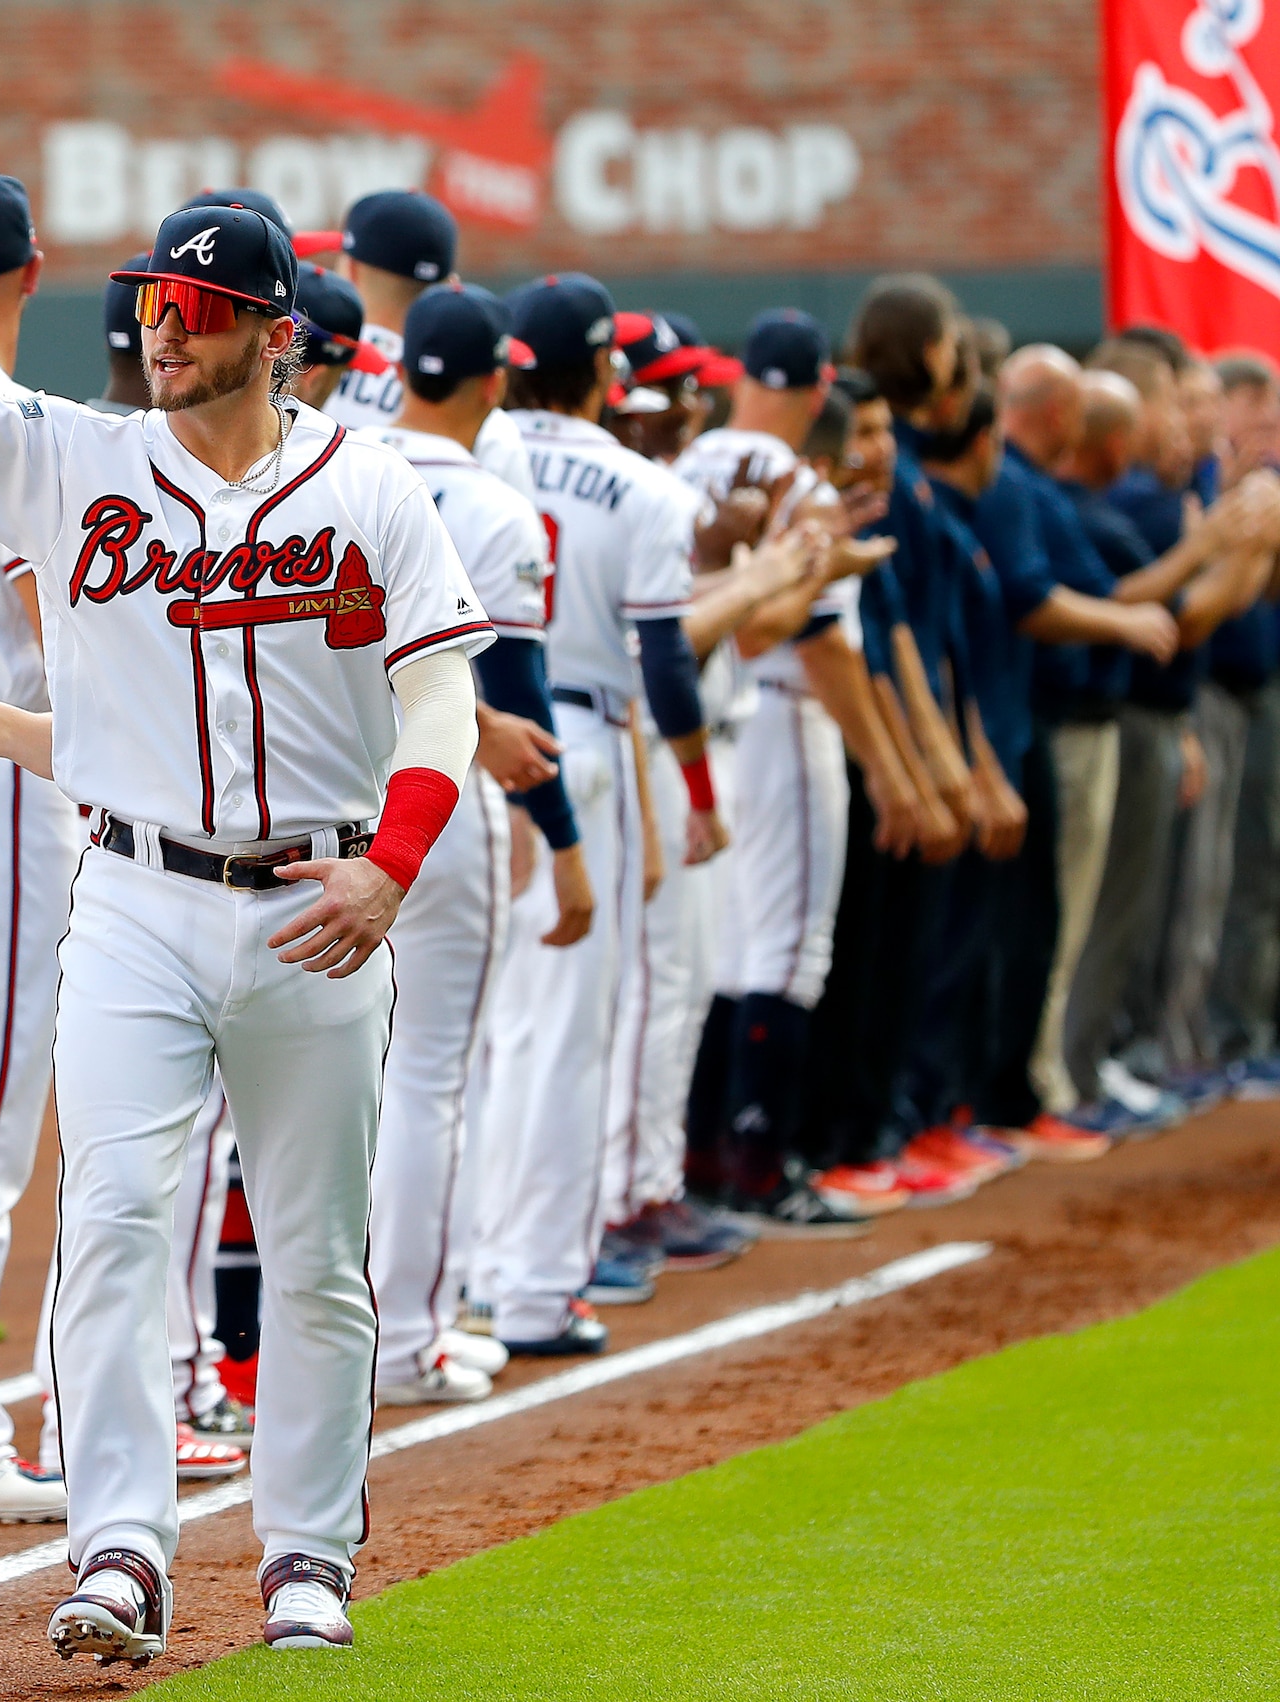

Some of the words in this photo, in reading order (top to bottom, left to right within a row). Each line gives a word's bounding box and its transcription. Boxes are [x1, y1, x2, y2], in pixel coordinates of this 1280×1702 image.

[554, 110, 861, 236] CHOP
[170, 226, 221, 266] A
[70, 495, 336, 607] Braves
[347, 841, 368, 859] 20
[293, 1560, 311, 1571] 20
